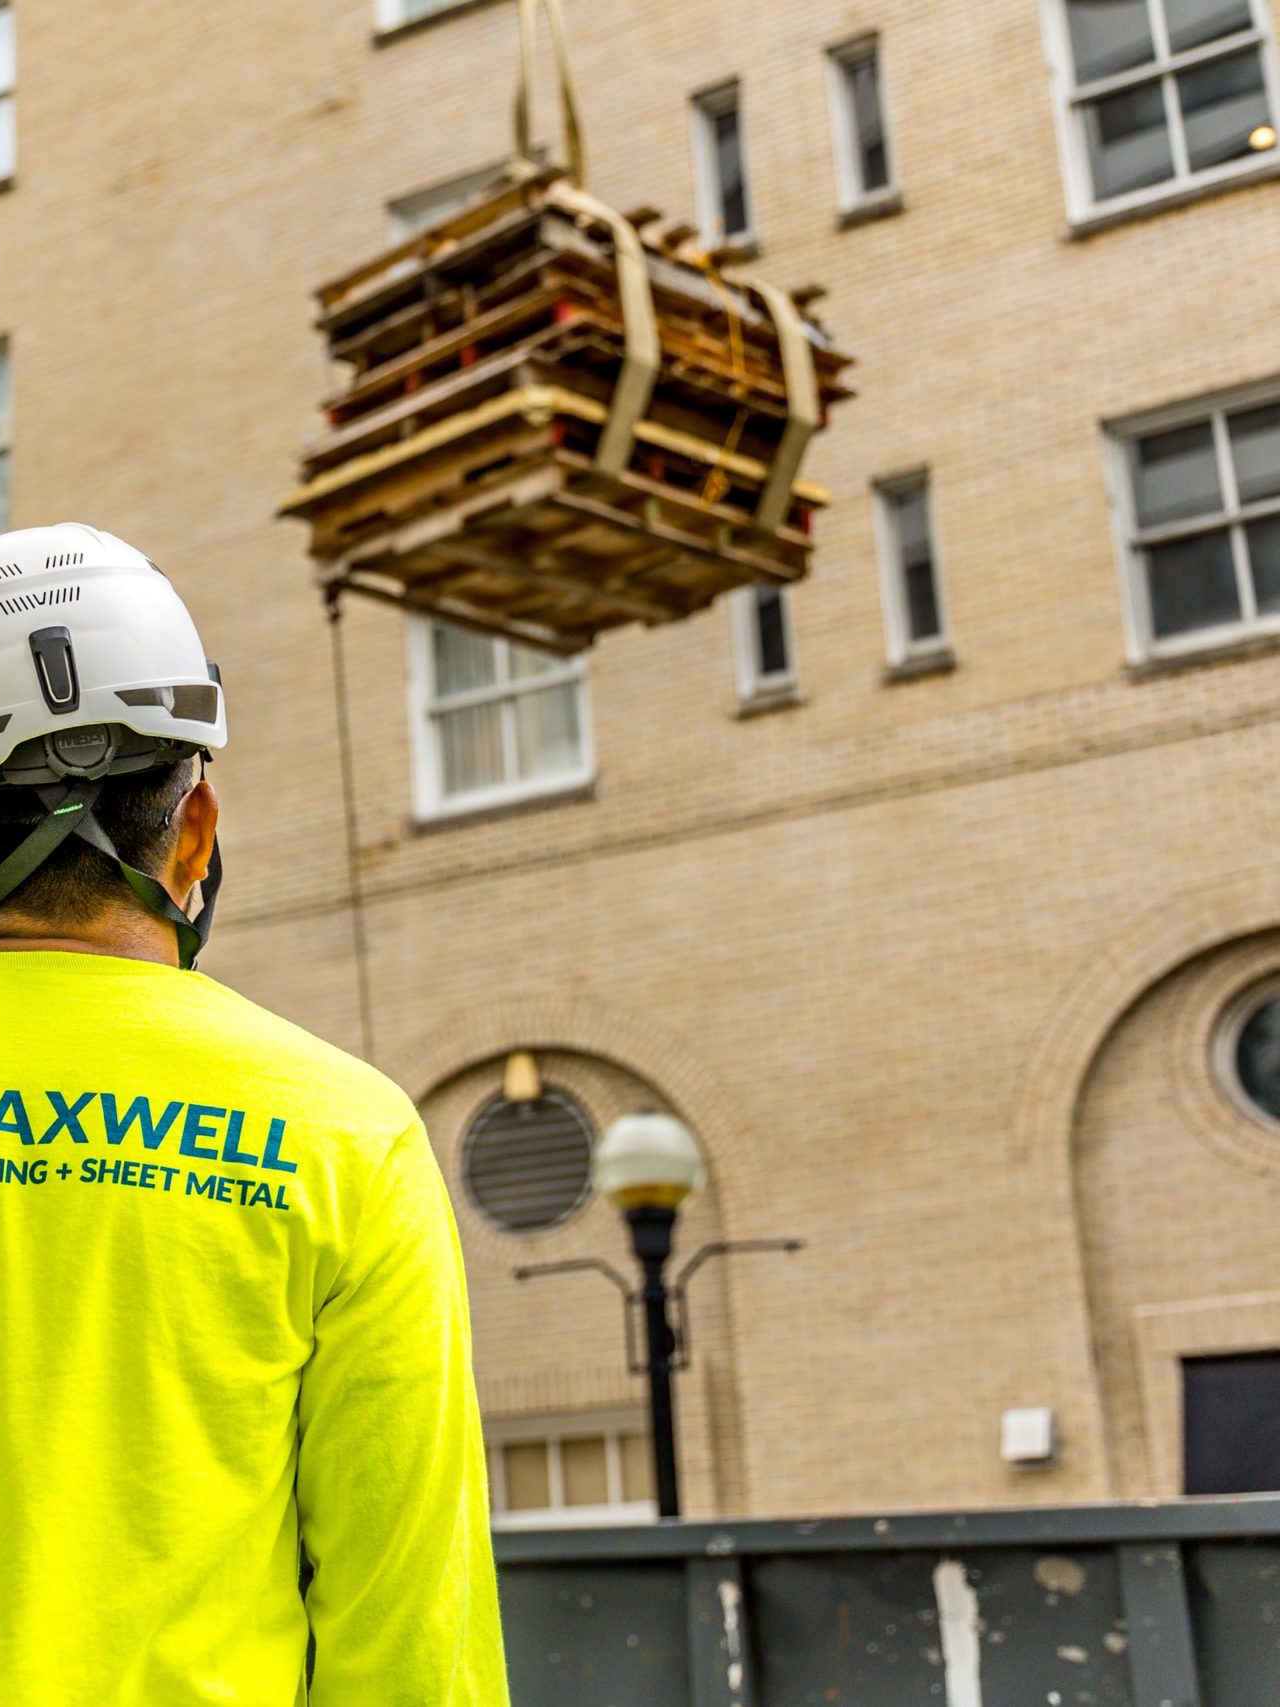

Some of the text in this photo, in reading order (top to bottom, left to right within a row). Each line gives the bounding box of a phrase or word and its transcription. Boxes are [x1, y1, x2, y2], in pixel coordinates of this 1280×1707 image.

[55, 1162, 73, 1181] +
[79, 1157, 181, 1192] SHEET
[185, 1171, 290, 1211] METAL
